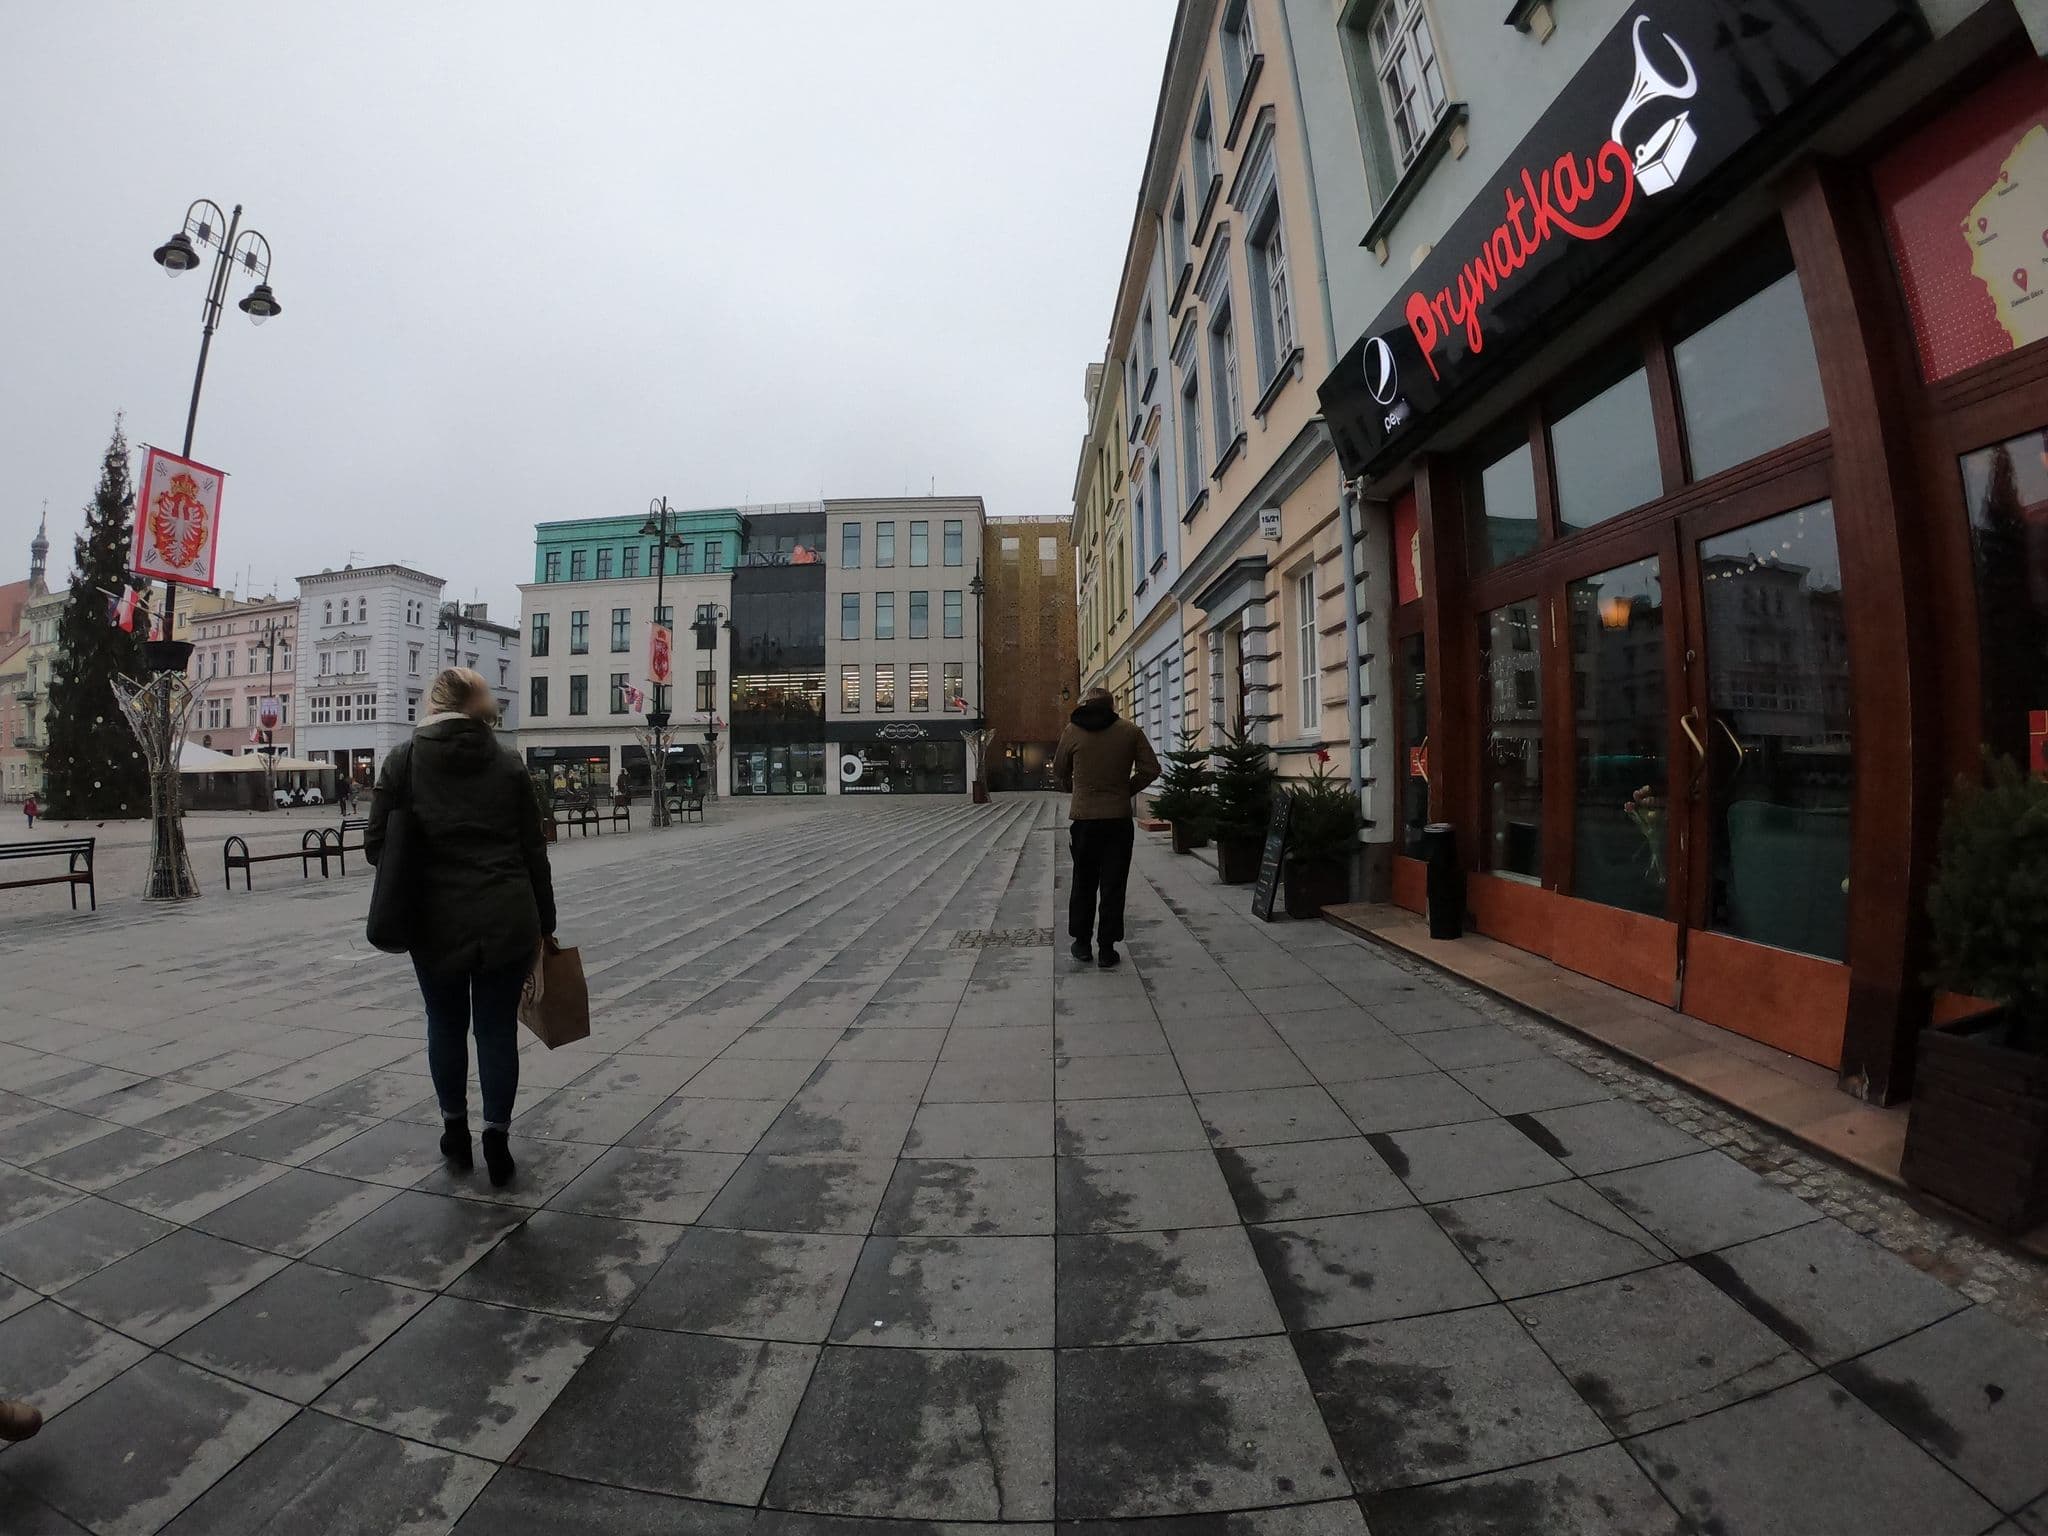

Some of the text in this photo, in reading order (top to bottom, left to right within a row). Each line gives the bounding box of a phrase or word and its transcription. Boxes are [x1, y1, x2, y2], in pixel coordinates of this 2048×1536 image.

[1405, 138, 1634, 381] Prywatka
[1261, 515, 1279, 523] 15/21
[748, 551, 787, 567] ING
